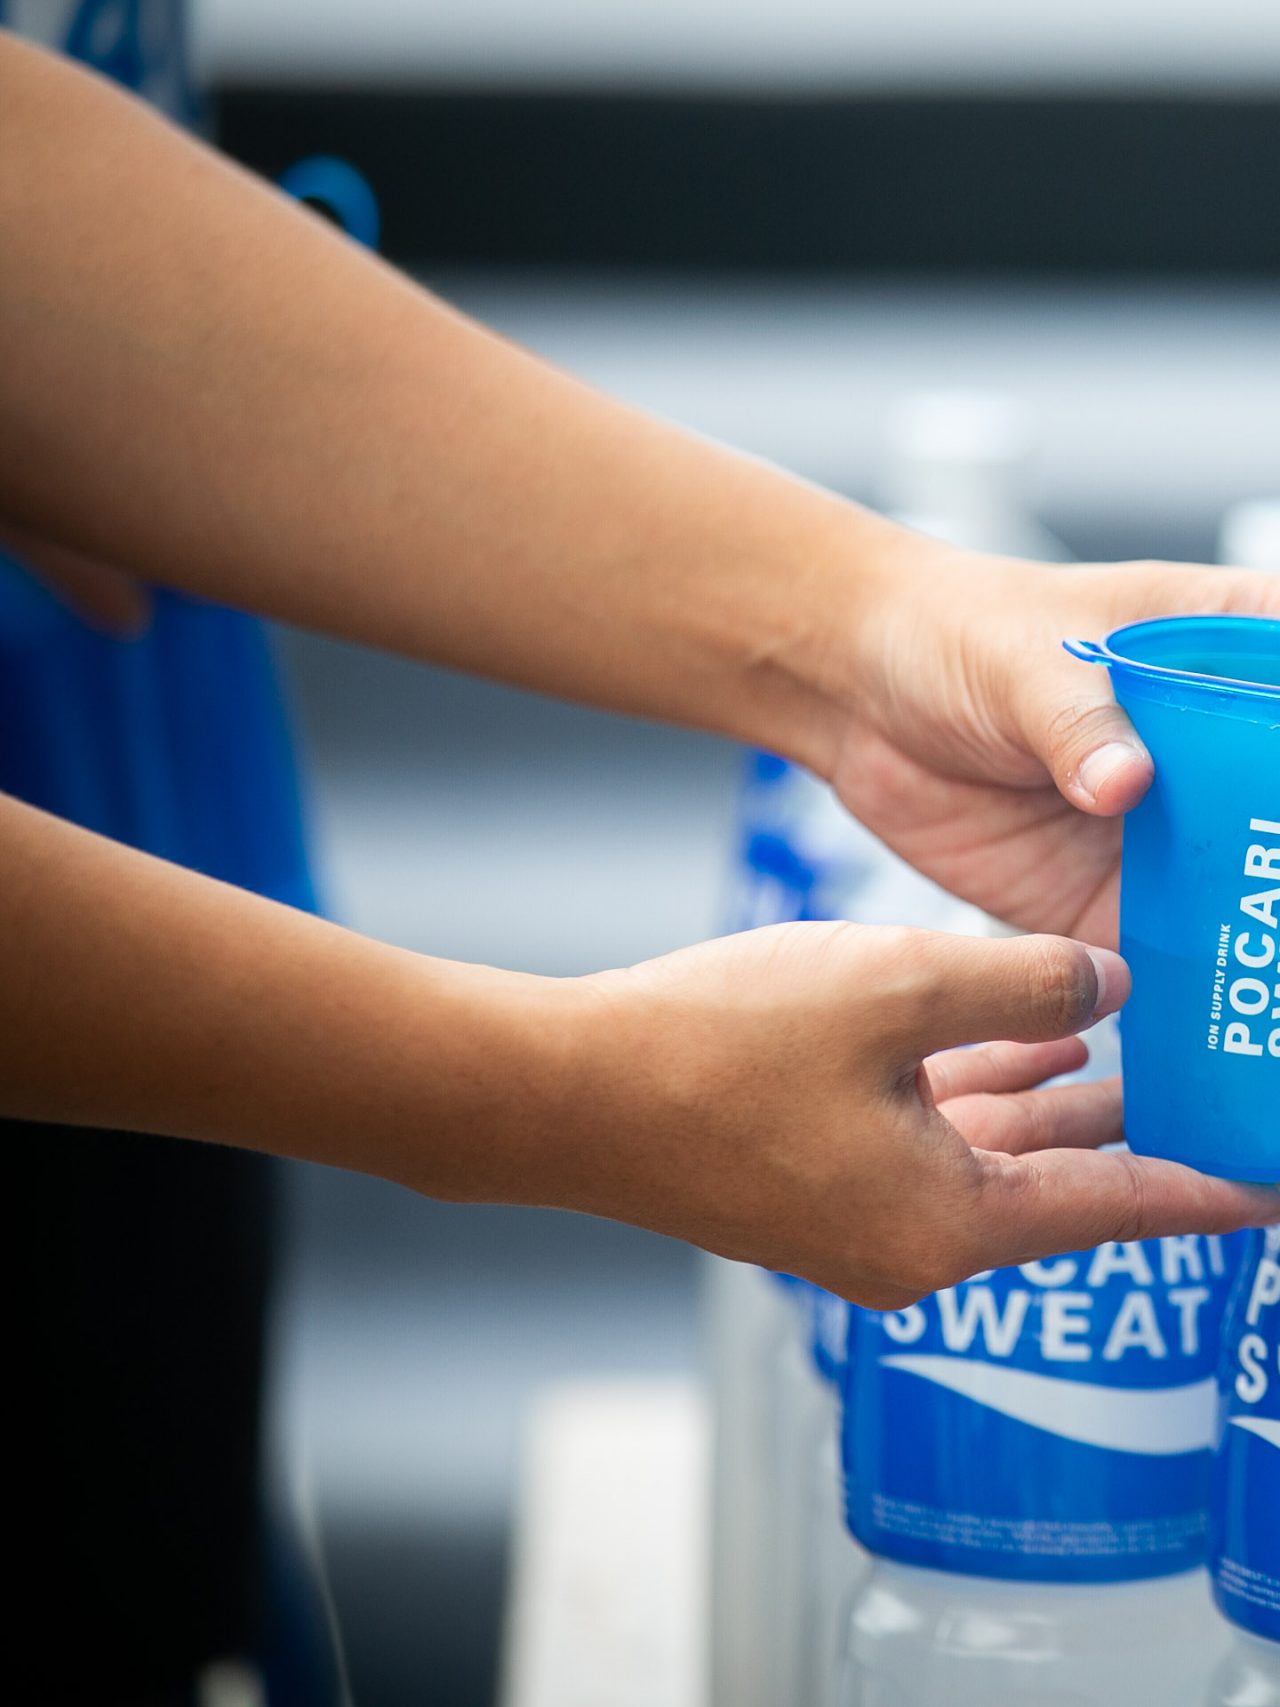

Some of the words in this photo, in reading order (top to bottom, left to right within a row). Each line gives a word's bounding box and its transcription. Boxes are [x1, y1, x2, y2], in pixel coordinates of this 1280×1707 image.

[1216, 923, 1231, 967] DRINK
[1210, 968, 1226, 1021] SUPPLY
[1207, 1024, 1220, 1050] ION
[964, 1233, 1225, 1287] CARI
[882, 1287, 1210, 1362] SWEAT
